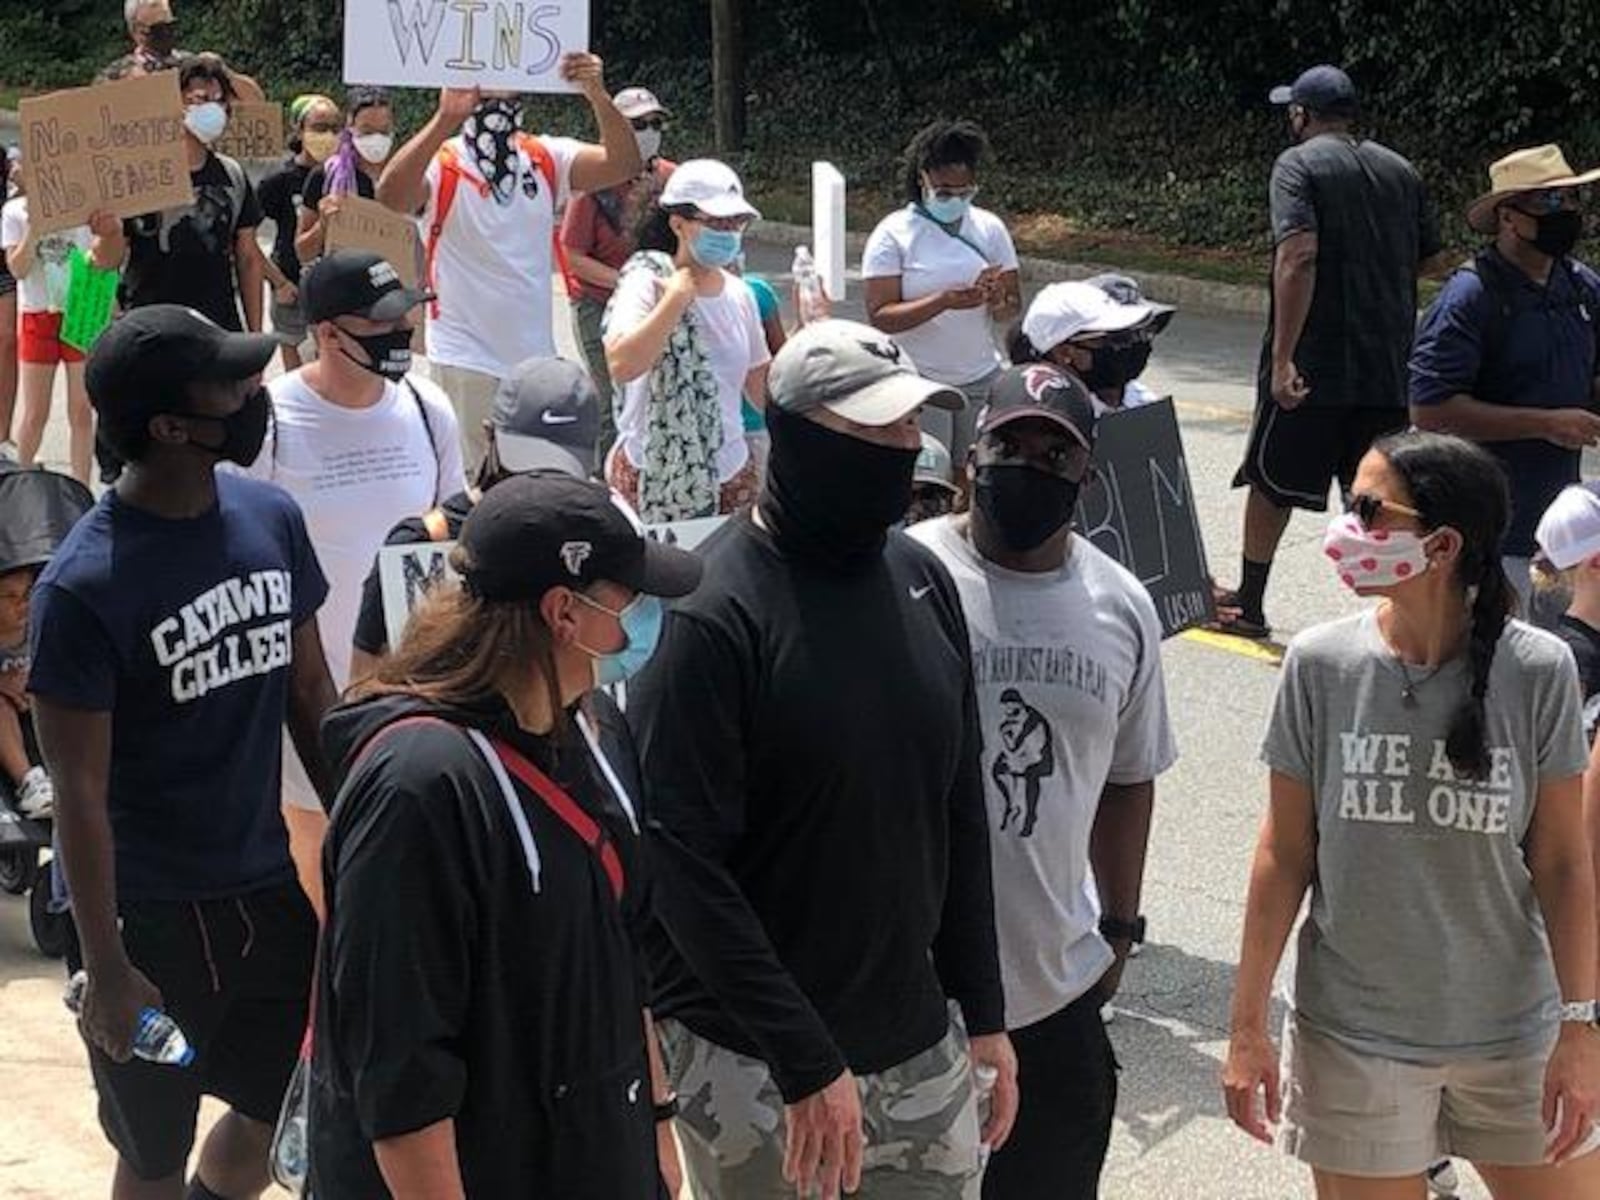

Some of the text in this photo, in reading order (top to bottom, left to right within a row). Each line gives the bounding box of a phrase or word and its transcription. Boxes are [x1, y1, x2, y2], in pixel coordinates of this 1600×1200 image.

[388, 0, 561, 75] WINS
[92, 154, 173, 201] PEACE
[151, 569, 292, 667] CATAWB
[1339, 732, 1512, 789] WE AE
[1338, 778, 1511, 834] ALL ONE
